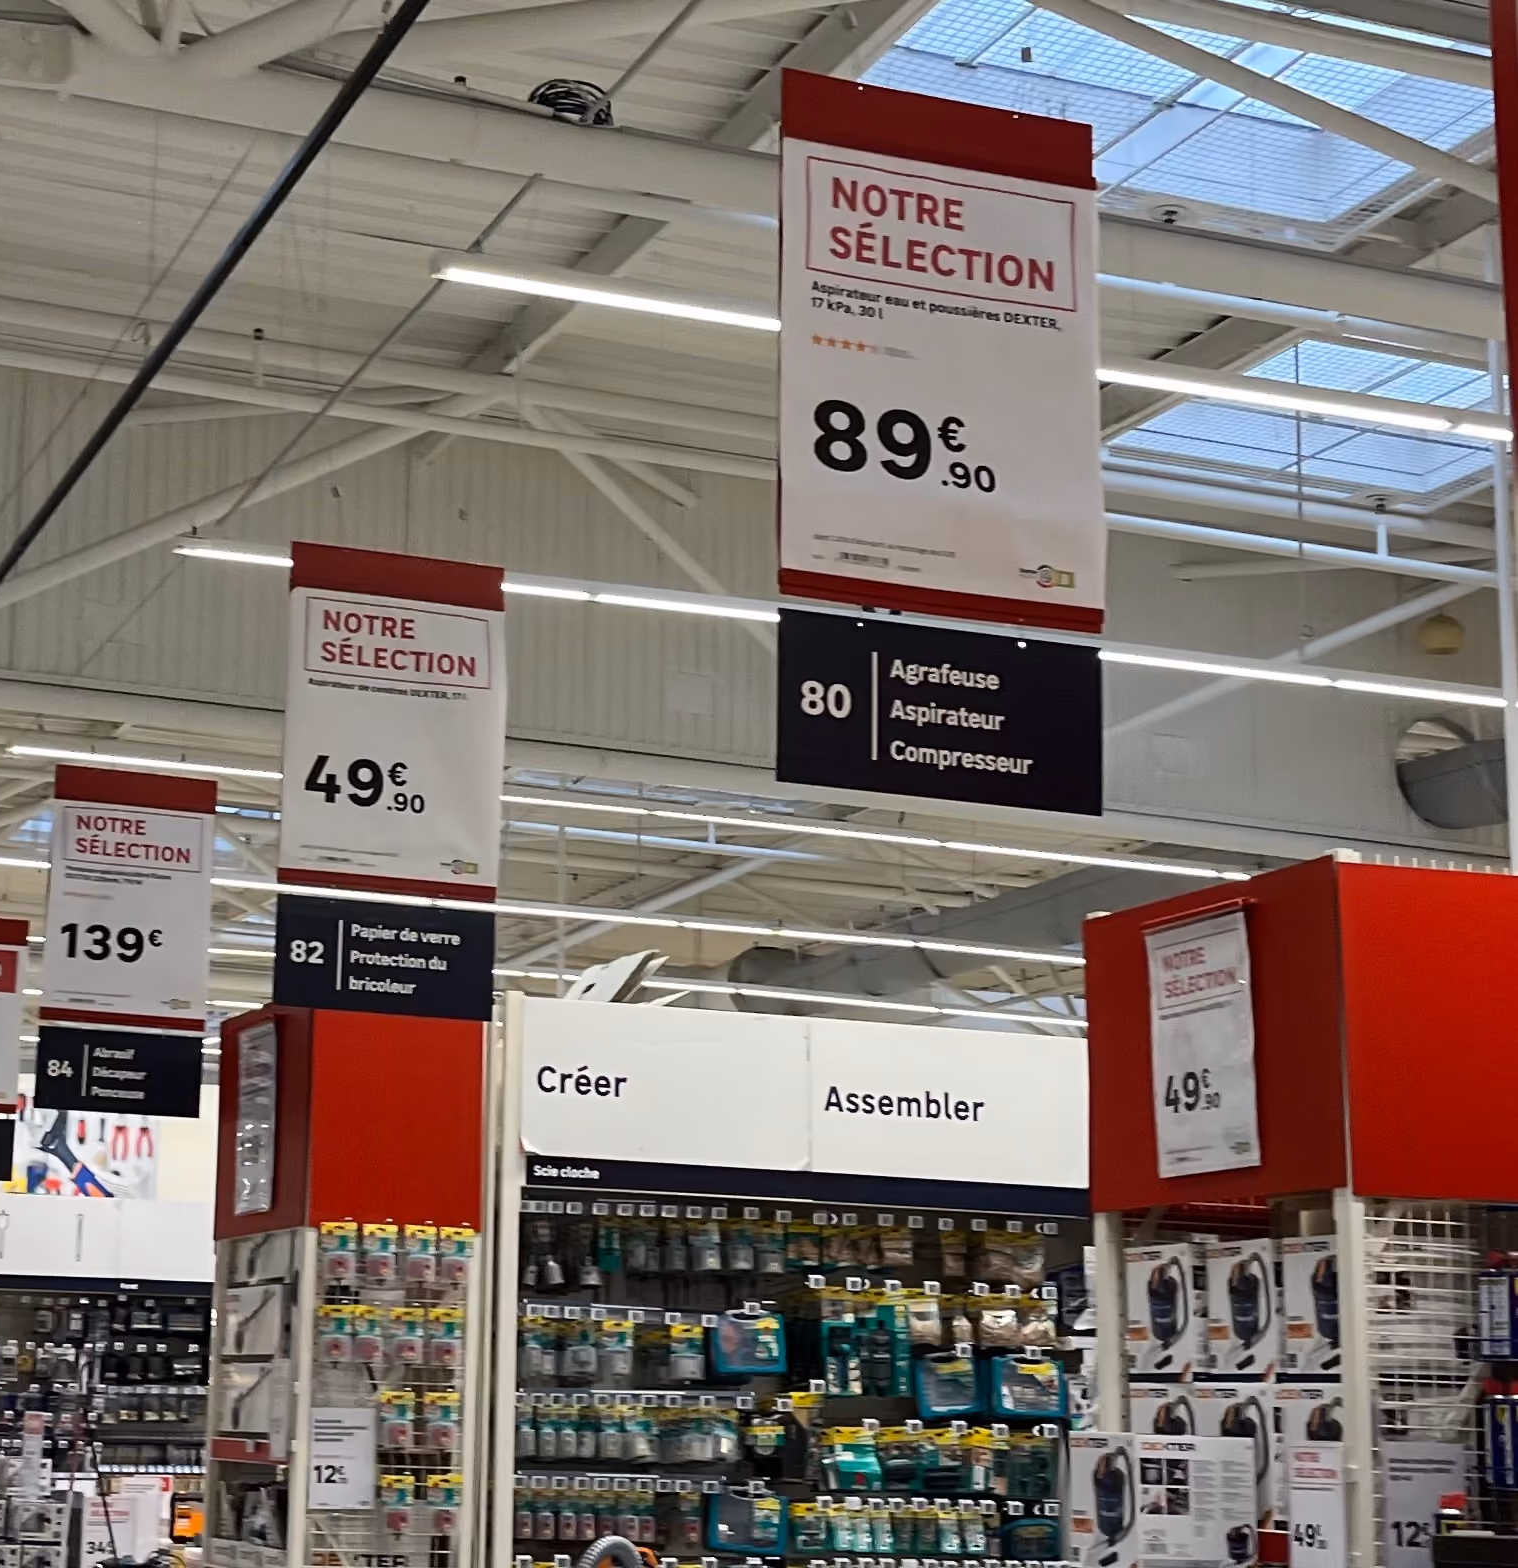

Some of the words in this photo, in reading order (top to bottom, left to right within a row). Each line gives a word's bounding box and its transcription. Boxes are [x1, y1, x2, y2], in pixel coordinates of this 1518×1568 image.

[831, 176, 965, 232] NOTRE
[829, 221, 1055, 292] SÉLECTION
[812, 281, 882, 304] Aspirateur
[885, 294, 909, 308] eau
[912, 297, 927, 311] et
[322, 609, 416, 640] NOTRE
[320, 637, 477, 677] SÉLECTION
[889, 658, 1001, 690] Agrafeuse
[800, 680, 852, 719] 80
[889, 699, 1005, 731] Aspirateur
[889, 740, 1034, 775] Compresseur
[76, 814, 147, 836] NOTRE
[75, 834, 191, 864] SÉLECTION
[350, 923, 398, 943] Papier
[399, 927, 419, 943] de
[420, 931, 462, 946] verre
[290, 939, 325, 965] 82
[349, 949, 427, 969] Protection
[428, 956, 448, 971] du
[348, 975, 418, 995] bricoleur
[46, 1059, 74, 1078] 84
[537, 1065, 629, 1098] Créer
[824, 1085, 985, 1122] Assembler
